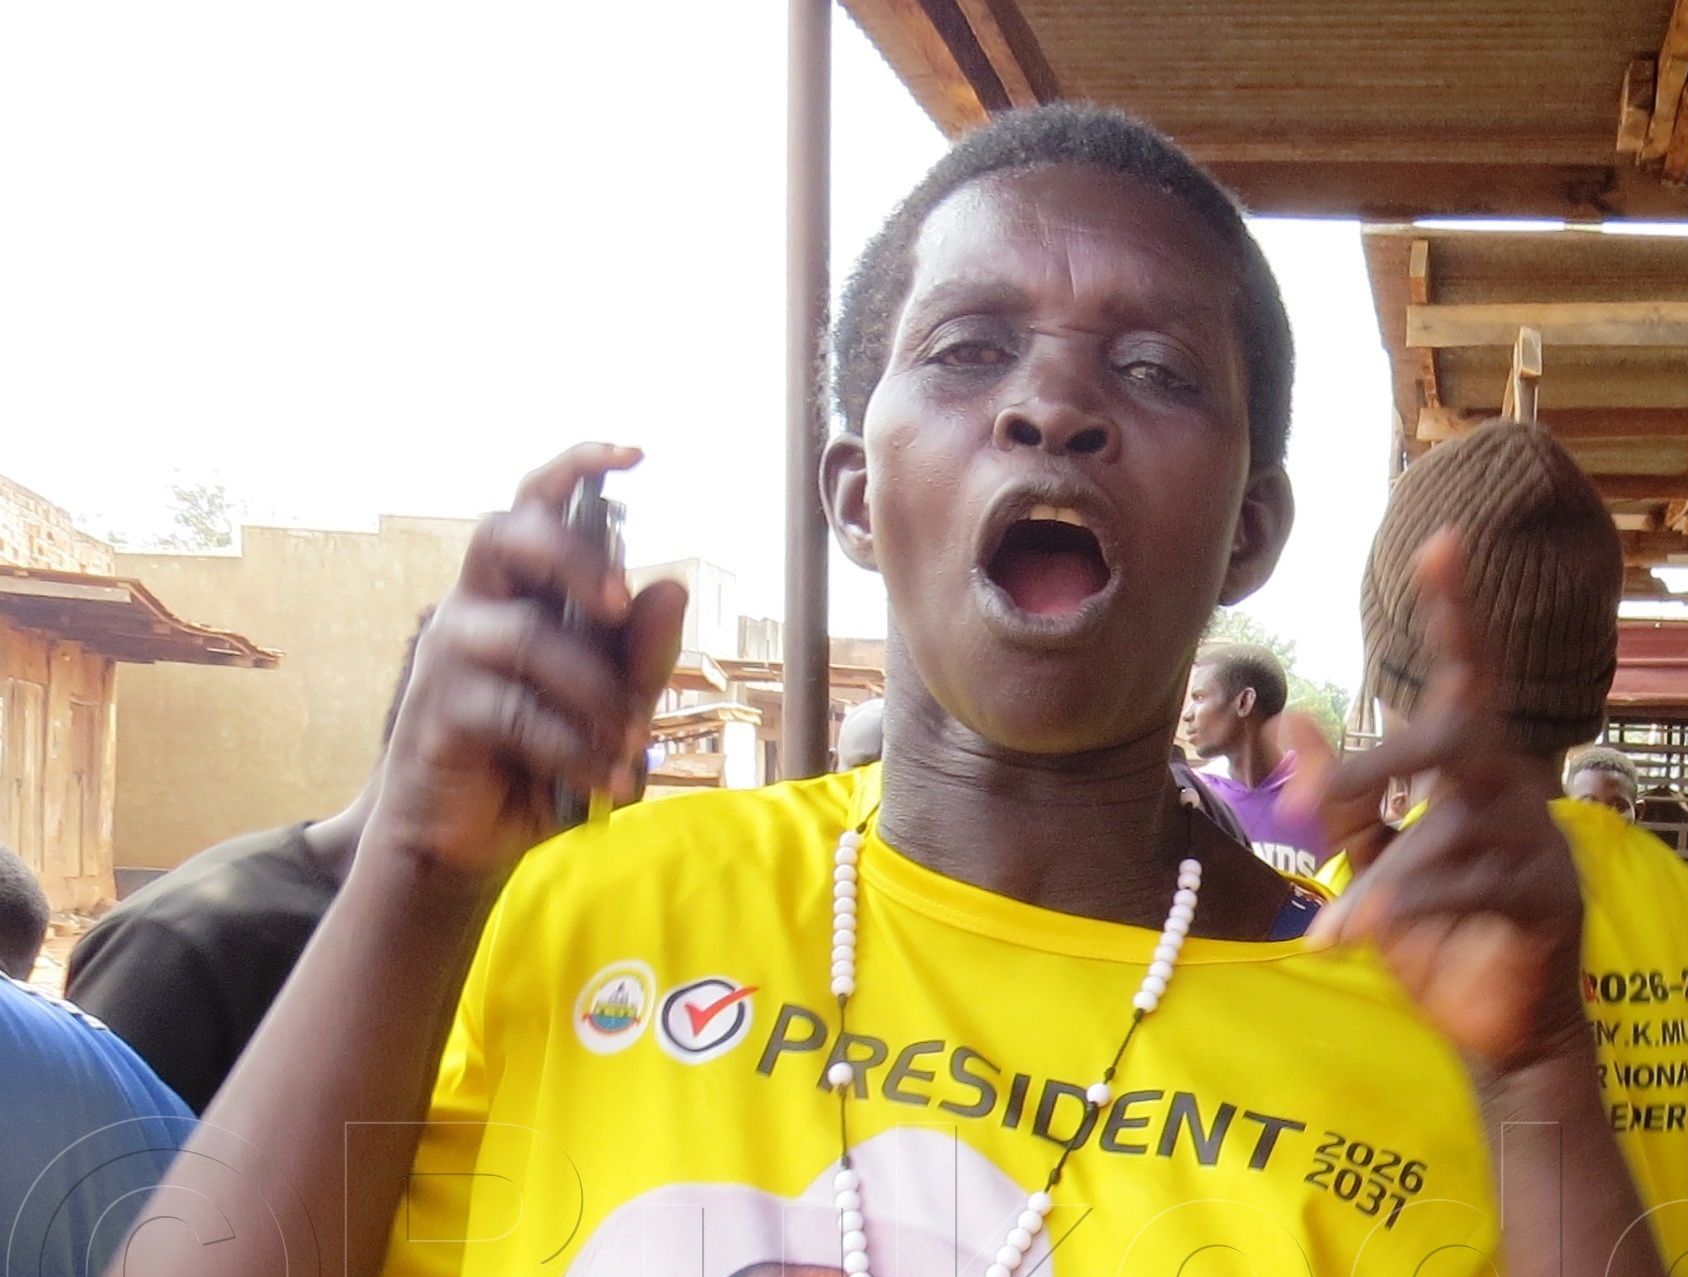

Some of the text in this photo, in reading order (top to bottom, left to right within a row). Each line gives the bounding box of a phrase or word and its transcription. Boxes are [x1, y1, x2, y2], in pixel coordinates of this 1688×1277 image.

[755, 1002, 1306, 1174] PRESIDENT
[1303, 1158, 1407, 1231] 2031
[1315, 1130, 1428, 1195] 2026
